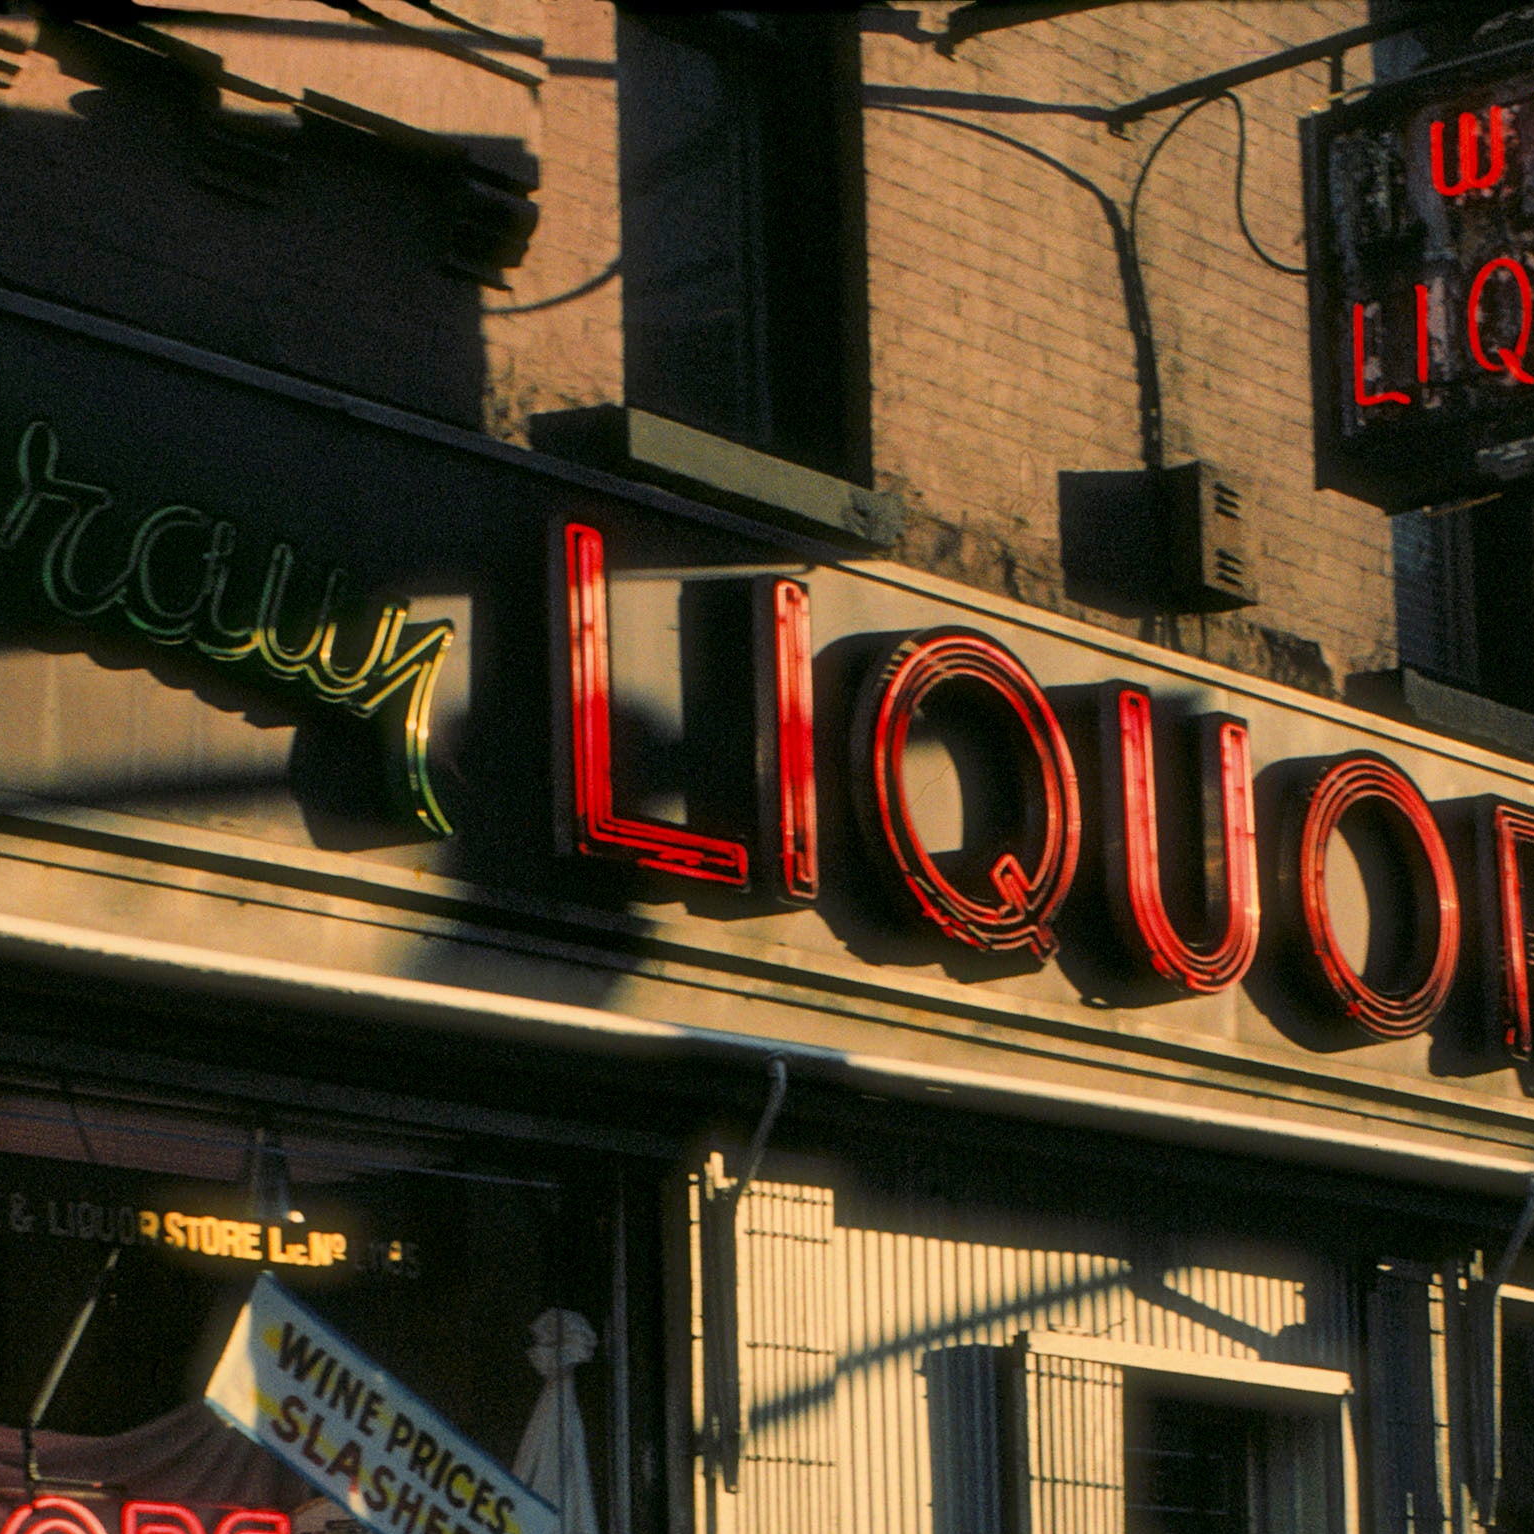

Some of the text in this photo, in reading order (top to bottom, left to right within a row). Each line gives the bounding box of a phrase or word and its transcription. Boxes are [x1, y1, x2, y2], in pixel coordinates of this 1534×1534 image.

[48, 1199, 161, 1247] LIQUOR
[163, 1210, 263, 1262] STORE
[271, 1320, 383, 1439] WINE
